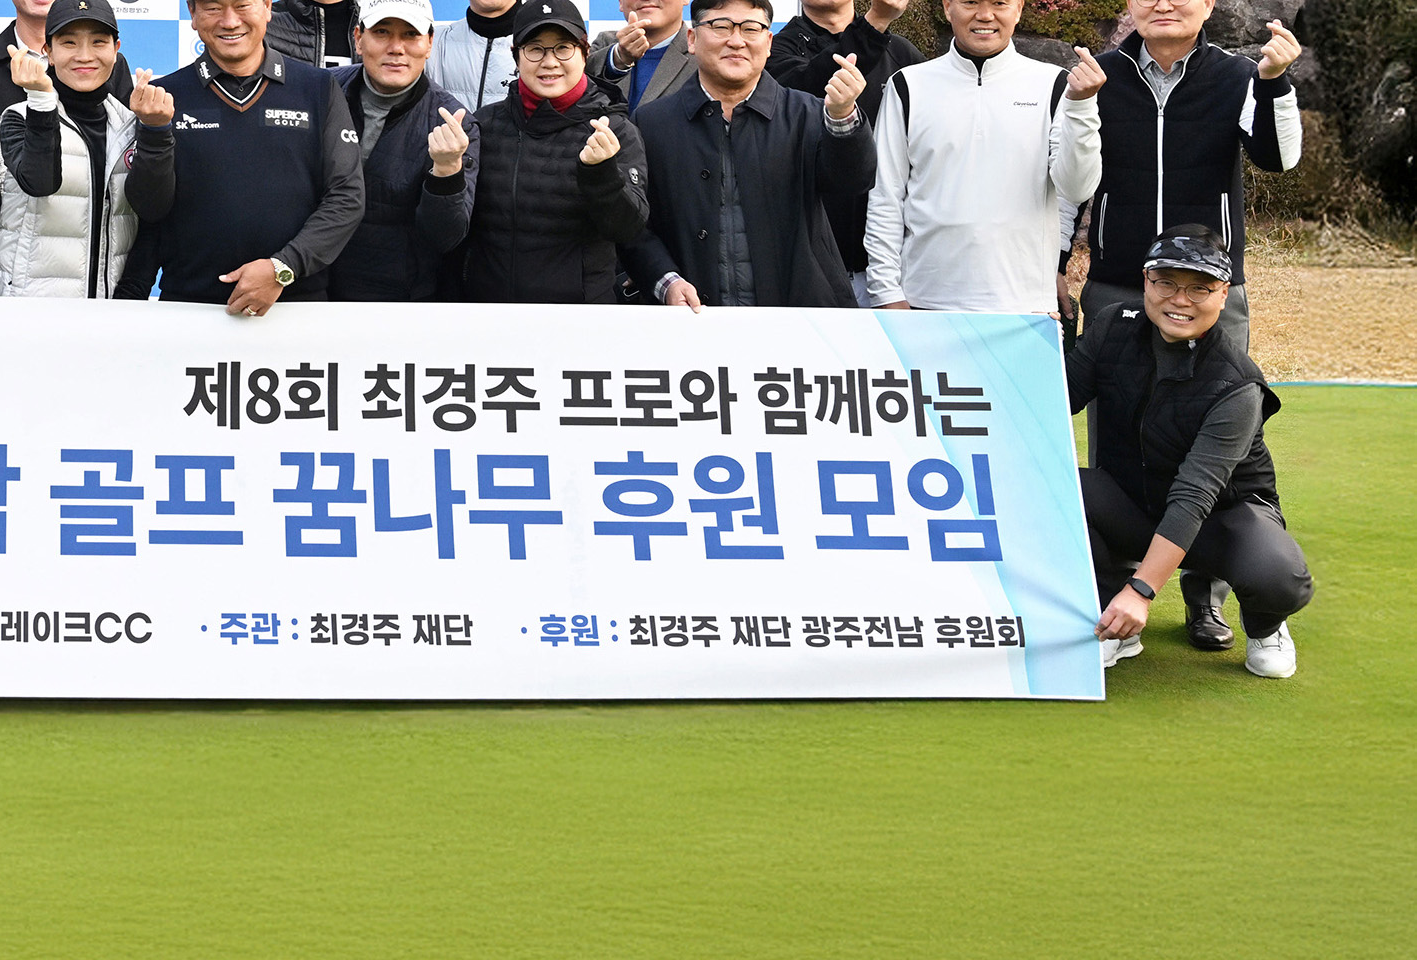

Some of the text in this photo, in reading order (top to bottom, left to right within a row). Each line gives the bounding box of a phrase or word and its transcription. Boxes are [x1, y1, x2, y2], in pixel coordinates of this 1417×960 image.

[175, 121, 188, 130] SK
[265, 109, 309, 121] SUPERIOR
[274, 119, 300, 127] GOLF
[182, 361, 992, 438] 제8회 최경주 프로와 함께하는
[50, 448, 244, 557] 골프
[272, 448, 563, 560] 꿈나무
[593, 450, 785, 561] 후원
[815, 453, 1004, 562] 모임
[310, 613, 402, 647] 최경주
[412, 614, 473, 646] 재단
[629, 614, 721, 648] 최경주
[730, 615, 792, 648] 재단
[801, 616, 924, 649] 광주전남
[934, 615, 1026, 648] 후원회
